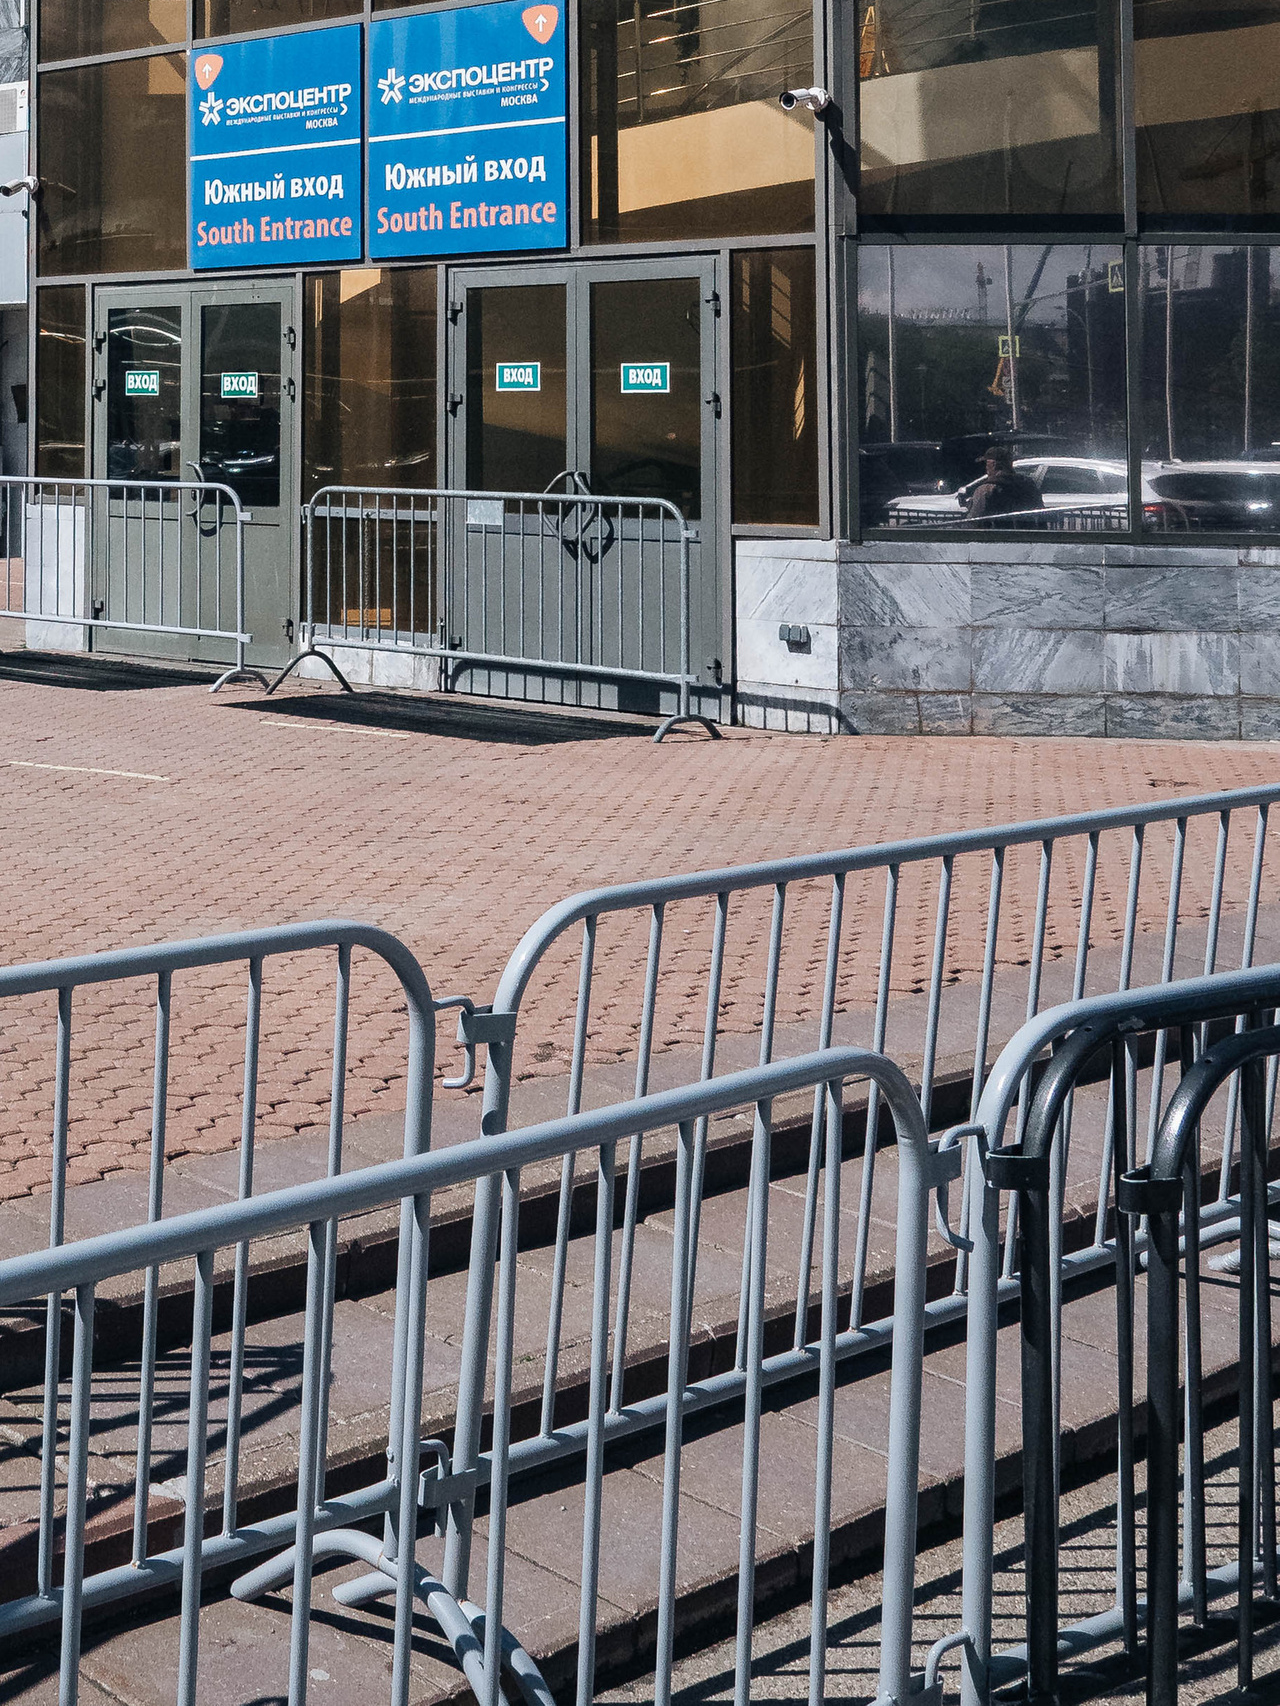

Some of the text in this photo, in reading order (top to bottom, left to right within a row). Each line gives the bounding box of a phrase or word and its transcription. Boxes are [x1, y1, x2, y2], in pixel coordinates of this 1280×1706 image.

[408, 56, 554, 93] ЭКСПОЦЕНТР
[225, 82, 352, 116] ЭКСПОЦЕНТР
[408, 92, 462, 104] МЕЖДУНАРОДНЫЕ
[462, 88, 495, 98] ВЫСТАВКИ
[501, 82, 539, 93] КОНГРЕССЫ
[500, 94, 538, 107] МОСКВА
[225, 114, 272, 126] МЕЖДУНАРОДНЫЕ
[272, 111, 301, 121] ВЫСТАВКИ
[306, 106, 339, 117] КОНГРЕССЫ
[305, 117, 338, 130] МОСКВА
[385, 154, 547, 191] Южный вход
[204, 172, 344, 205] Южный вход
[377, 201, 557, 234] South Entrance
[197, 216, 353, 247] South Entrance
[127, 374, 157, 392] ВХОД
[223, 375, 256, 394] ВХОД
[503, 367, 533, 386] ВХОД
[628, 368, 662, 387] ВХОД
